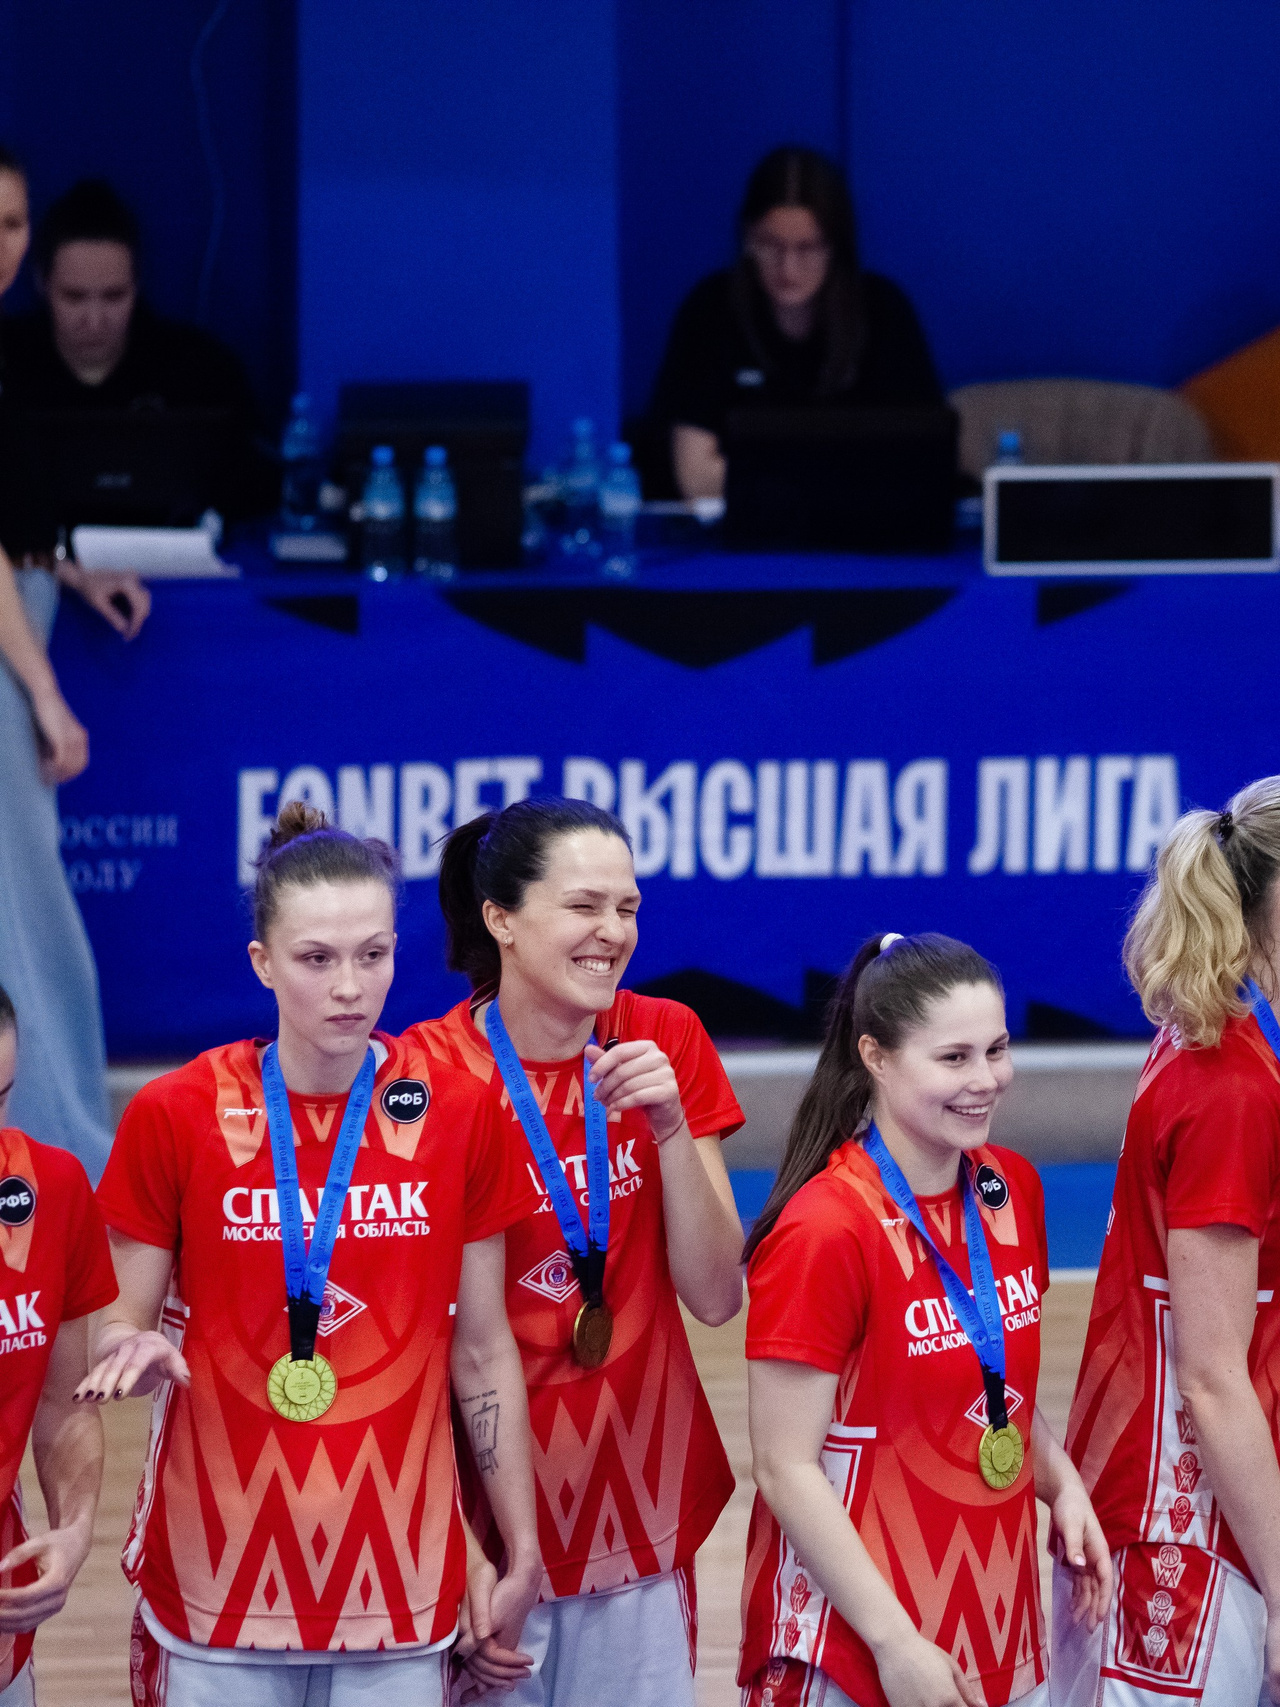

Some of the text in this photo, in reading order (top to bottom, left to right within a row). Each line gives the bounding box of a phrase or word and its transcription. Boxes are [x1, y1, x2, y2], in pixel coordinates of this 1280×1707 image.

[56, 815, 178, 847] ОССИИ
[968, 754, 1181, 876] ЛИГА
[388, 1092, 423, 1106] РФБ
[591, 1101, 600, 1123] ССИИ
[222, 1181, 429, 1224] СПАТАК
[579, 1174, 643, 1207] ОАСТЬ
[353, 1221, 430, 1238] ОБЛАСТЬ
[904, 1265, 1039, 1338] СПААК
[0, 1331, 47, 1356] ЛАСТЬ
